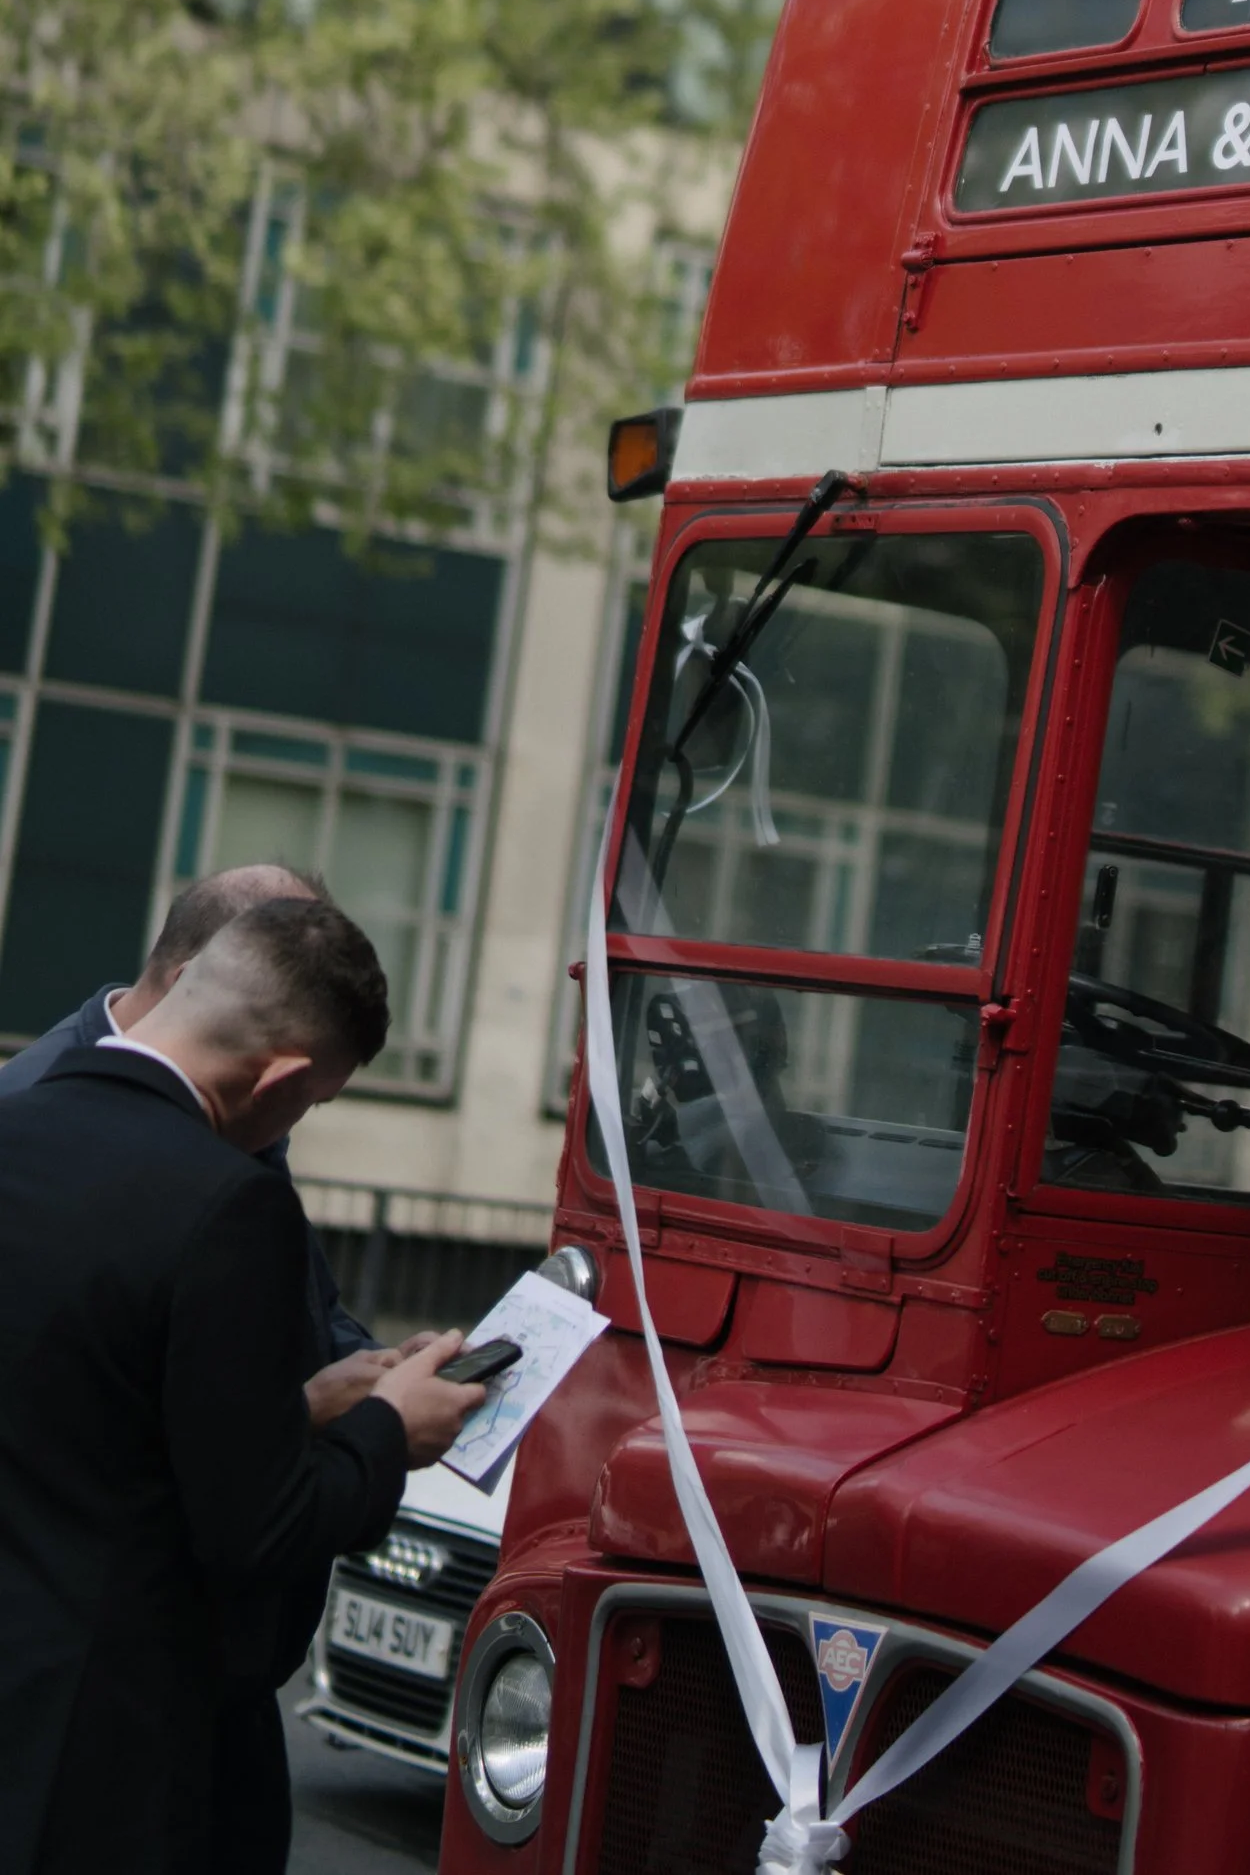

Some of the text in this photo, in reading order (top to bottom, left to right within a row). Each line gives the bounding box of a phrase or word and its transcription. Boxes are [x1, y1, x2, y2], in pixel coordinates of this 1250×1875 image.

[999, 110, 1189, 193] ANNA
[389, 1613, 436, 1663] SUY
[821, 1646, 862, 1676] AEC
